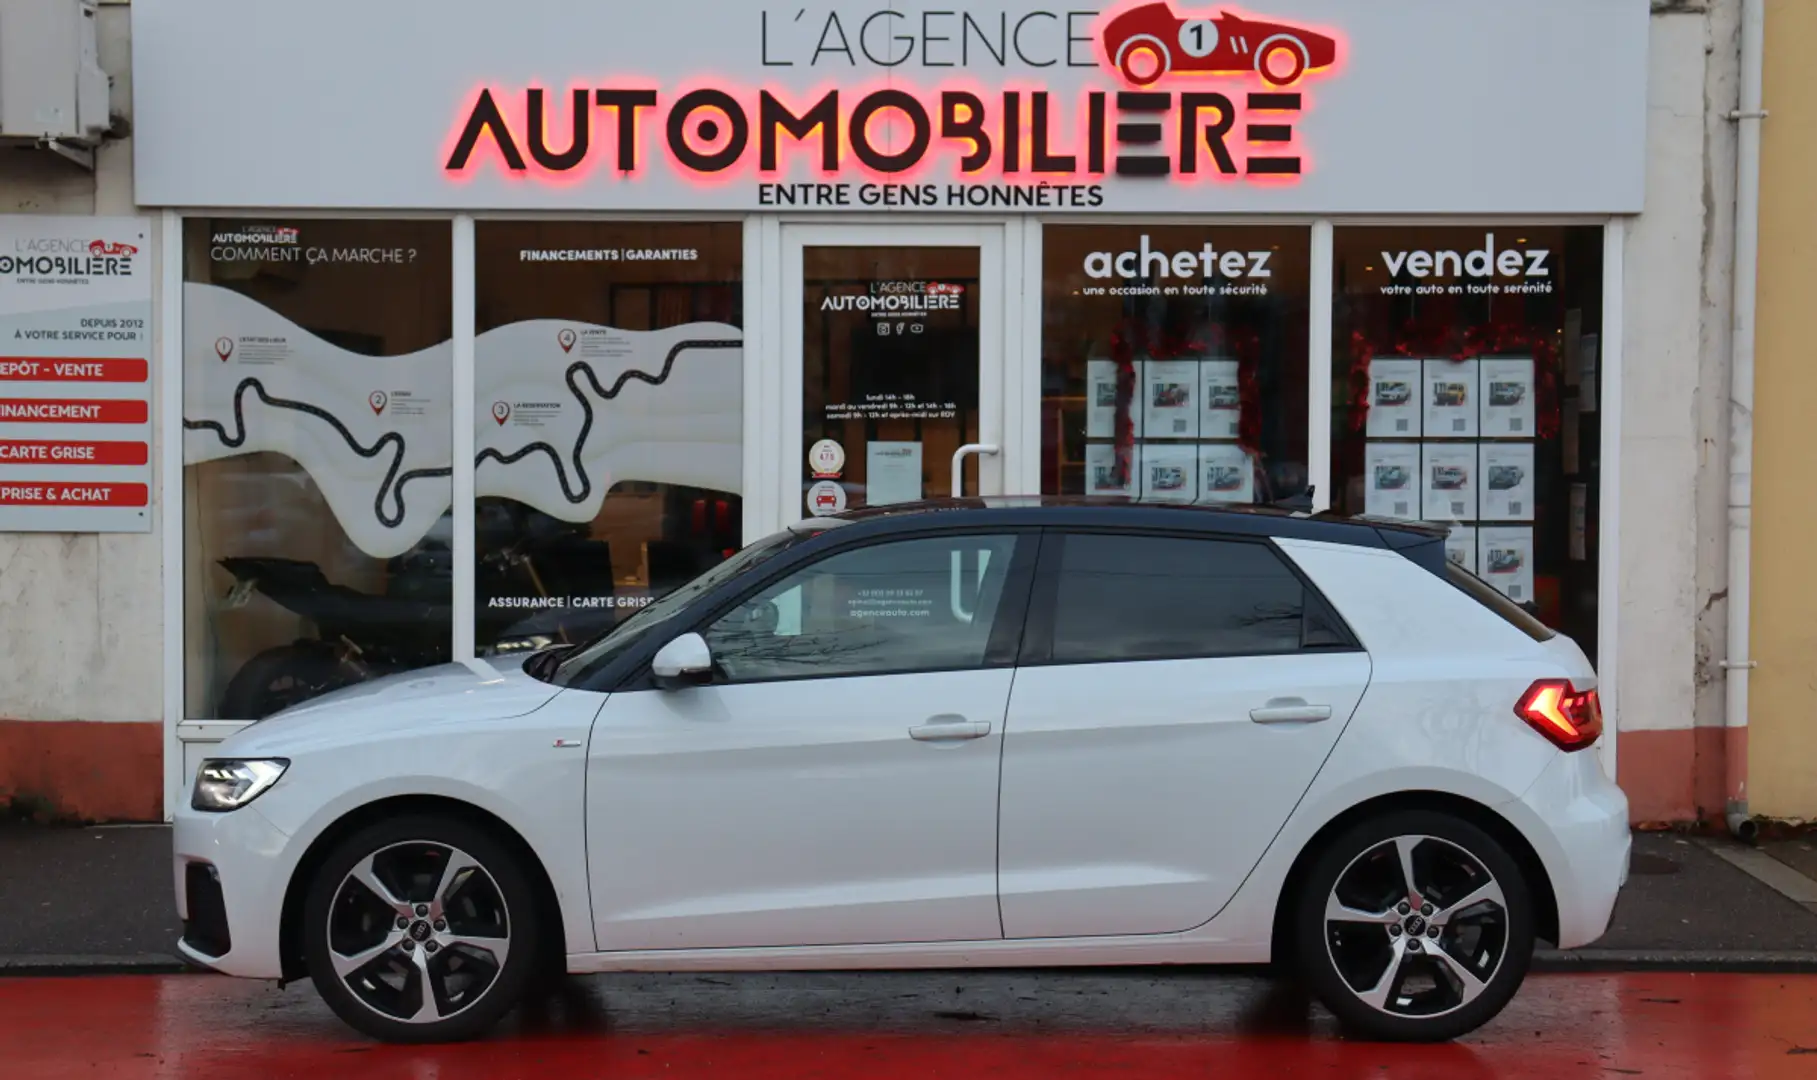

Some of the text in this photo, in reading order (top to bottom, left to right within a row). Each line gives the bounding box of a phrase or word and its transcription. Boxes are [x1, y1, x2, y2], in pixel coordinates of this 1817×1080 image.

[762, 8, 1100, 67] L'AGENCE
[1190, 23, 1202, 50] 1
[758, 181, 1104, 207] ENTRE GENS HONNÊTES
[15, 238, 90, 253] L'AGENCE
[210, 246, 417, 265] COMMENT ÇA MARCHE ?
[520, 248, 698, 261] FINANCEMENTS GARANTIES
[1083, 234, 1272, 279] achetez
[1380, 232, 1550, 278] vendez
[870, 281, 926, 294] L'AGENCE
[1082, 282, 1268, 296] une occasion en toute sécurité
[1380, 284, 1412, 295] votre
[1415, 284, 1444, 294] auto
[1448, 285, 1463, 294] en
[1467, 283, 1500, 294] toute
[80, 318, 144, 329] DEPUIS 2012
[25, 330, 60, 340] VOTRE
[62, 330, 104, 341] SERVICE
[107, 331, 136, 341] POUR
[0, 360, 40, 376] EPÔT
[53, 363, 104, 377] VENTE
[866, 393, 884, 401] lundi
[858, 402, 888, 410] vendredi
[0, 445, 95, 460] CARTE GRISE
[46, 487, 57, 500] &
[60, 487, 112, 501] ACHAT
[487, 596, 564, 608] ASSURANCE
[572, 596, 614, 608] CARTE
